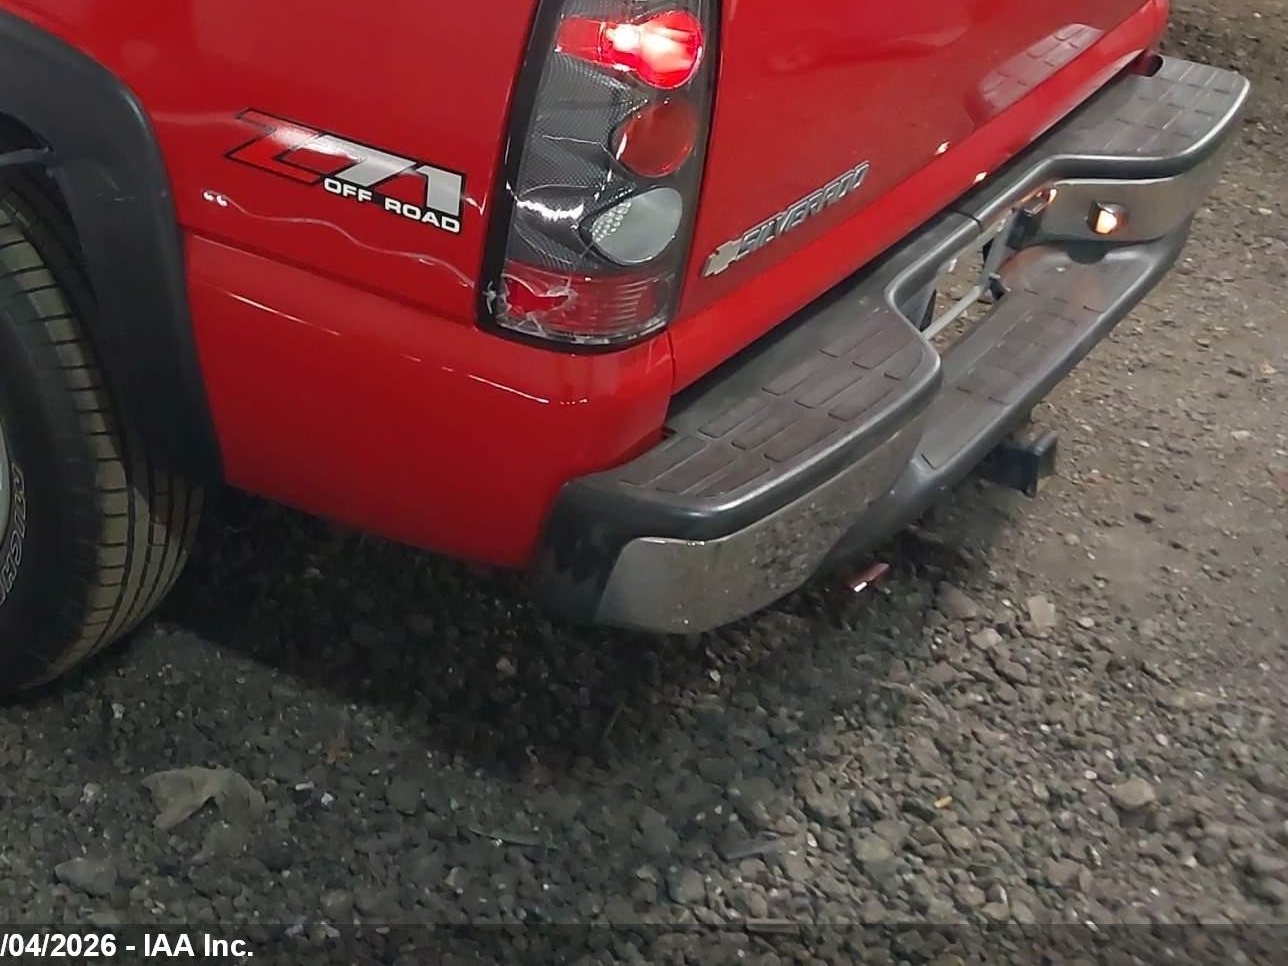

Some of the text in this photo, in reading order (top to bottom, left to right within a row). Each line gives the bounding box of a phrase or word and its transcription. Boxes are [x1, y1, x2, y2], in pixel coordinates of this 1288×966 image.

[223, 107, 467, 218] Z71
[322, 176, 461, 234] OFF ROAD
